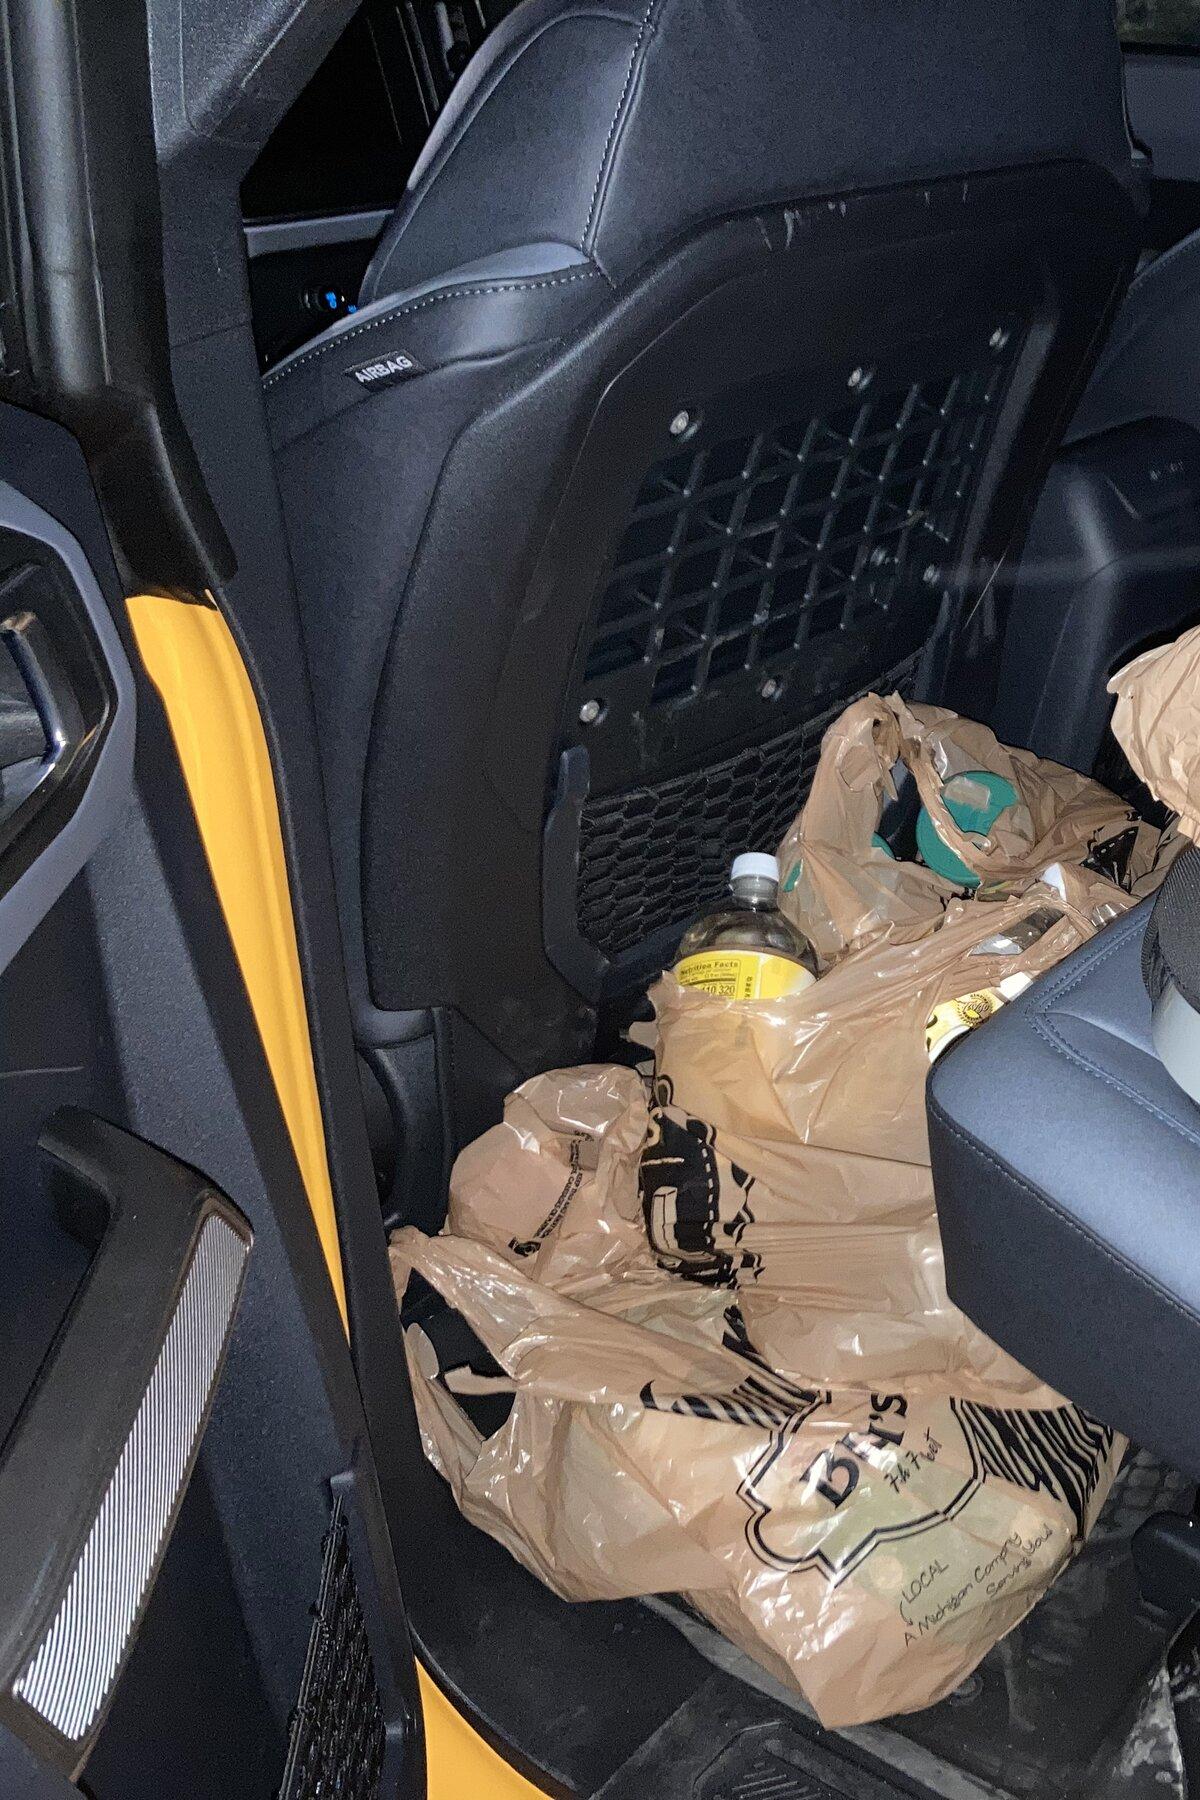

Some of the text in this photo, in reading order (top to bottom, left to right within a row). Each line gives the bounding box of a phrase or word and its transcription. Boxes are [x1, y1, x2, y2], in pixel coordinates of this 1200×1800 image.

[355, 356, 413, 383] AIRBAG
[681, 963, 712, 975] Nutrition
[719, 985, 735, 994] 320
[902, 1559, 949, 1604] LOCAL
[904, 1632, 917, 1647] A
[918, 1583, 974, 1635] Michigan
